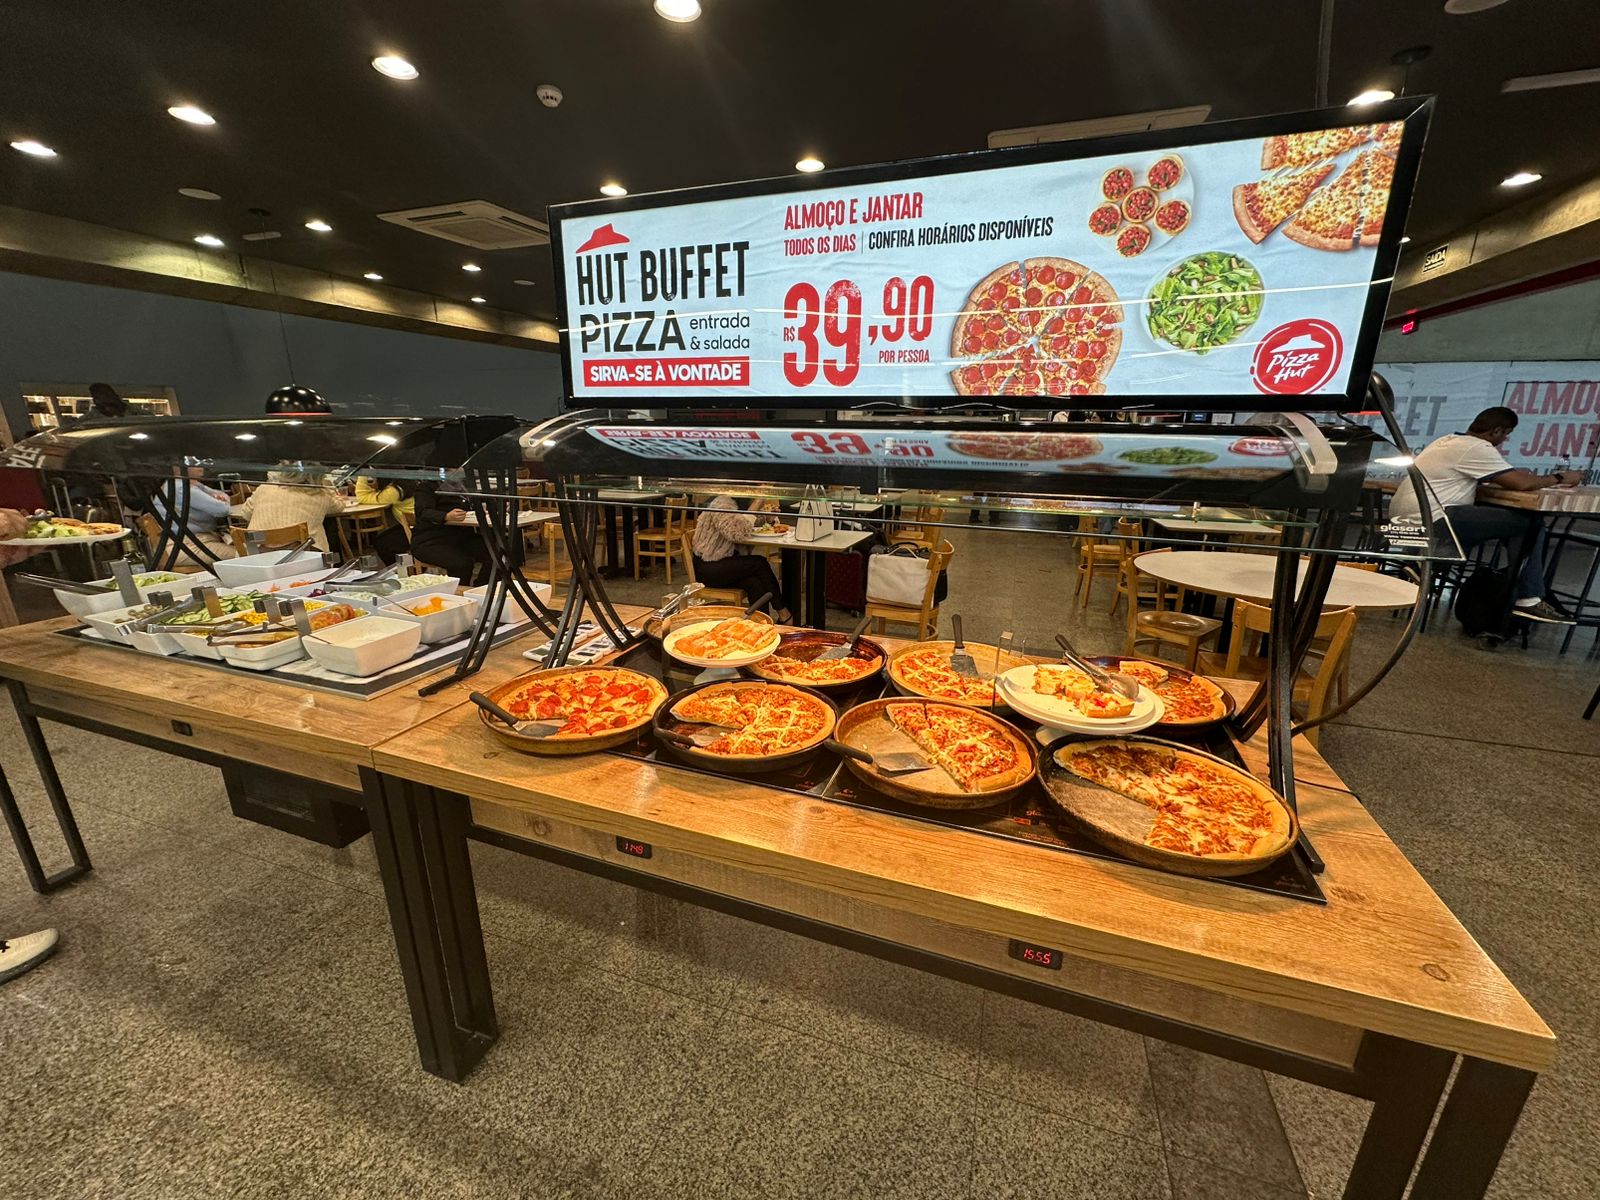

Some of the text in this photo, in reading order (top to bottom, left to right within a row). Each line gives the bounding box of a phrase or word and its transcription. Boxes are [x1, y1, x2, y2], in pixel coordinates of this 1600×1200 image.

[784, 191, 924, 231] ALMOÇO E JANTAR
[783, 215, 1054, 257] TODOS OS DIAS CONFIRA HORÁRIOS DISPONÍVEIS
[576, 241, 750, 306] HUT BUFFET
[580, 309, 686, 353] PIZZA
[690, 312, 750, 331] entrada
[690, 334, 750, 350] & salada
[783, 326, 796, 342] R$
[879, 349, 930, 363] POR PESSOA
[1266, 351, 1320, 374] Pizza
[590, 360, 742, 382] SIRVA-SE À VONTADE
[1274, 364, 1316, 385] Hut
[1380, 523, 1427, 533] glasart
